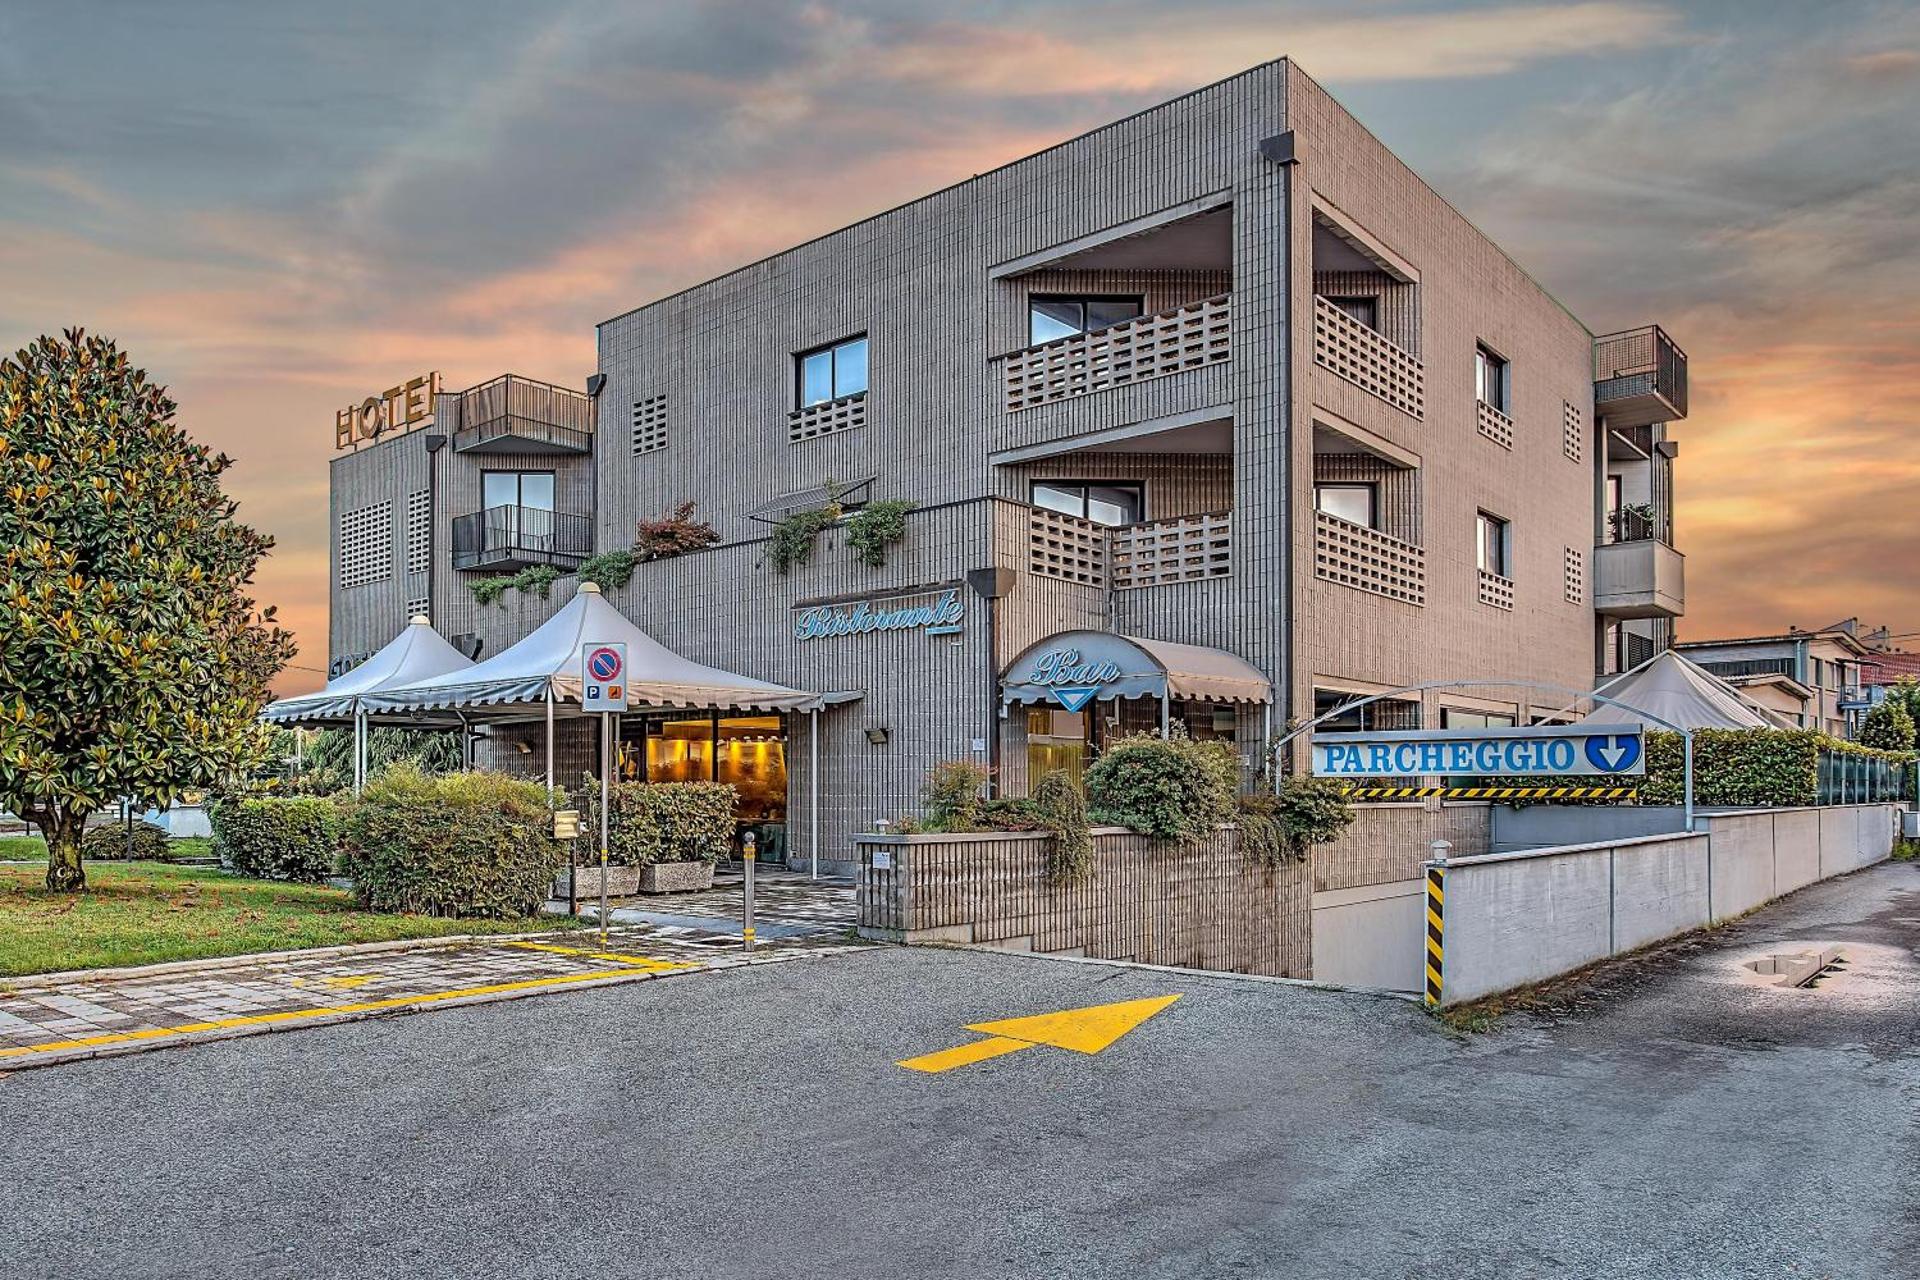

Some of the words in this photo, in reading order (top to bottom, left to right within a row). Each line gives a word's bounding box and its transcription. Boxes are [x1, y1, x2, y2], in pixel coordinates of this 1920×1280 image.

[795, 590, 964, 640] Ristorante
[1029, 648, 1121, 686] Bar
[1323, 739, 1576, 773] PARCHEGGIO
